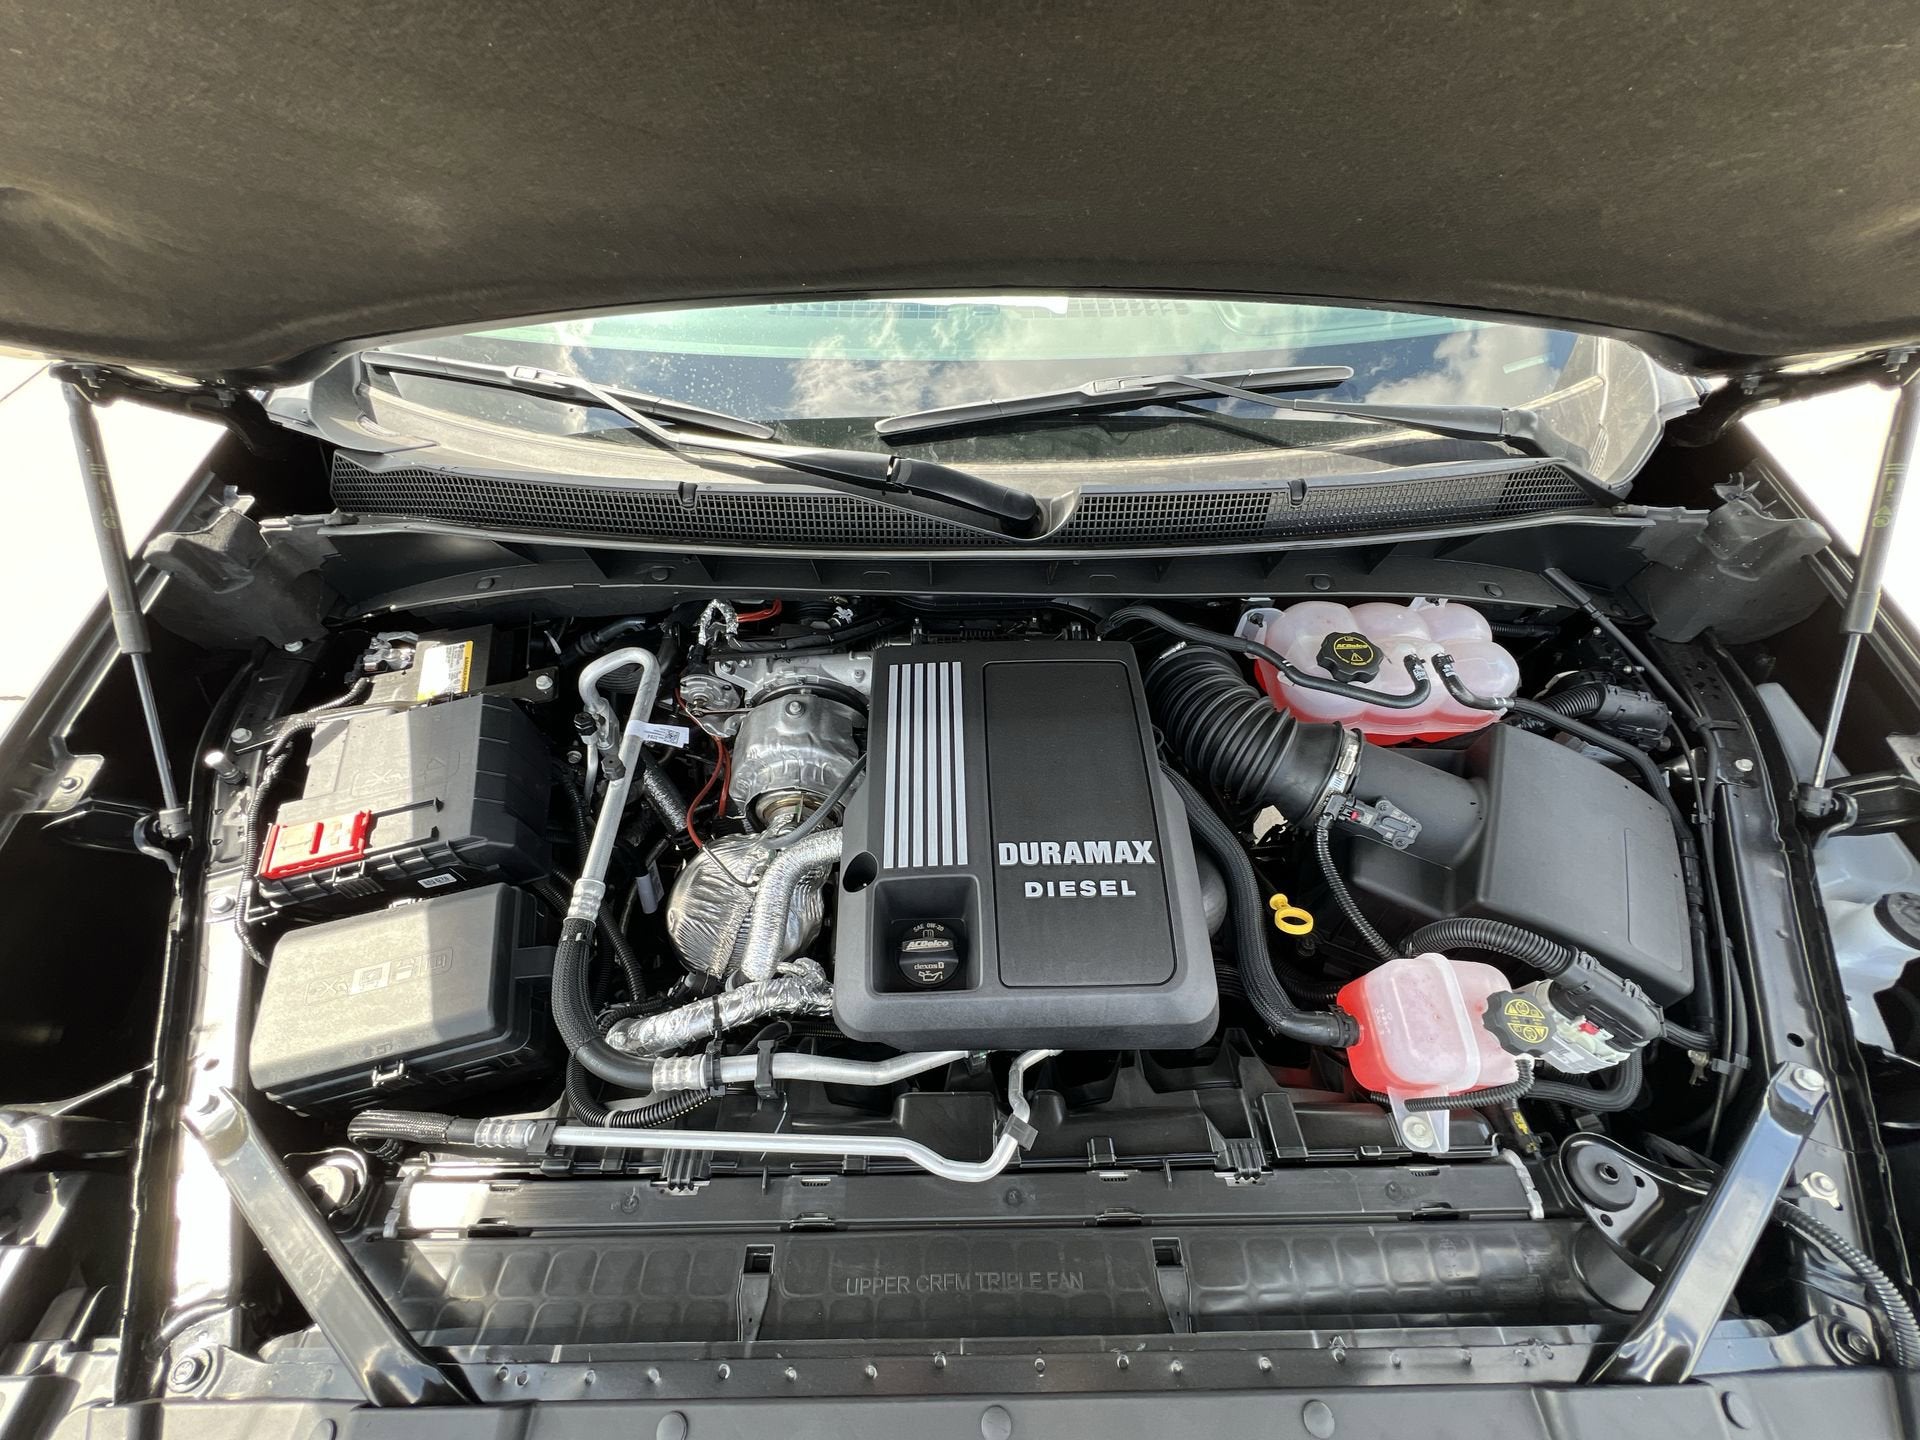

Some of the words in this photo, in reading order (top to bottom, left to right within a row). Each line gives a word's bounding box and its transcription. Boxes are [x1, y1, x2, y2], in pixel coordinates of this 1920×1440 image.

[998, 840, 1155, 867] DURAMAX
[1024, 879, 1137, 898] DIESEL
[905, 939, 950, 950] ACDelco
[846, 1275, 911, 1297] UPPER
[916, 1272, 971, 1294] CRFM
[975, 1271, 1043, 1291] TRIPLE
[1047, 1271, 1084, 1291] FAN
